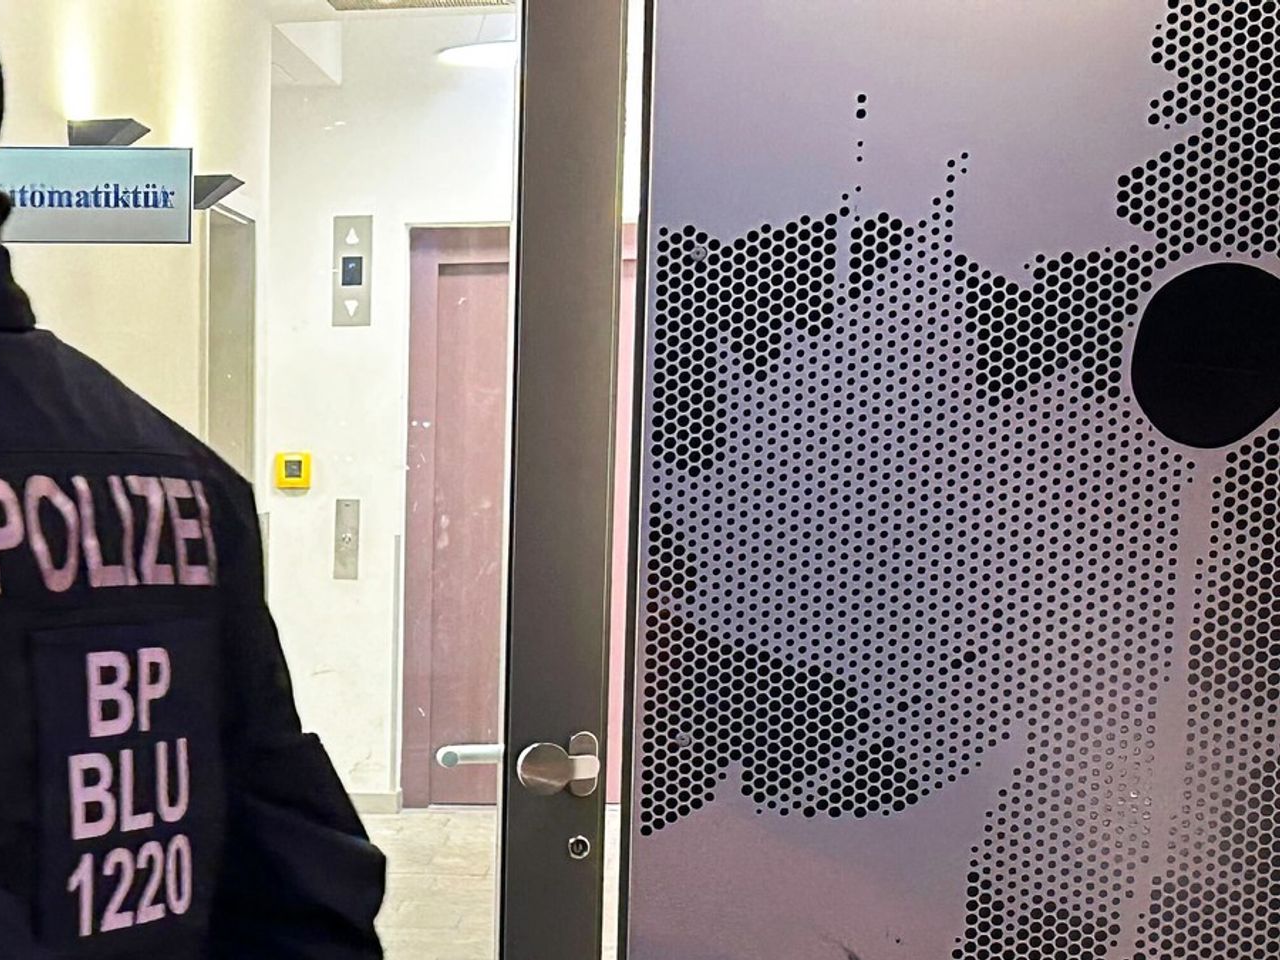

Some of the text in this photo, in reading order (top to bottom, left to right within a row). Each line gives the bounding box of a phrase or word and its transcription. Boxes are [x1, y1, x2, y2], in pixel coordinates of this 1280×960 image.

[8, 183, 175, 208] tomatiktür
[86, 647, 171, 737] BP
[68, 738, 189, 839] BLU
[67, 834, 192, 936] 1220
